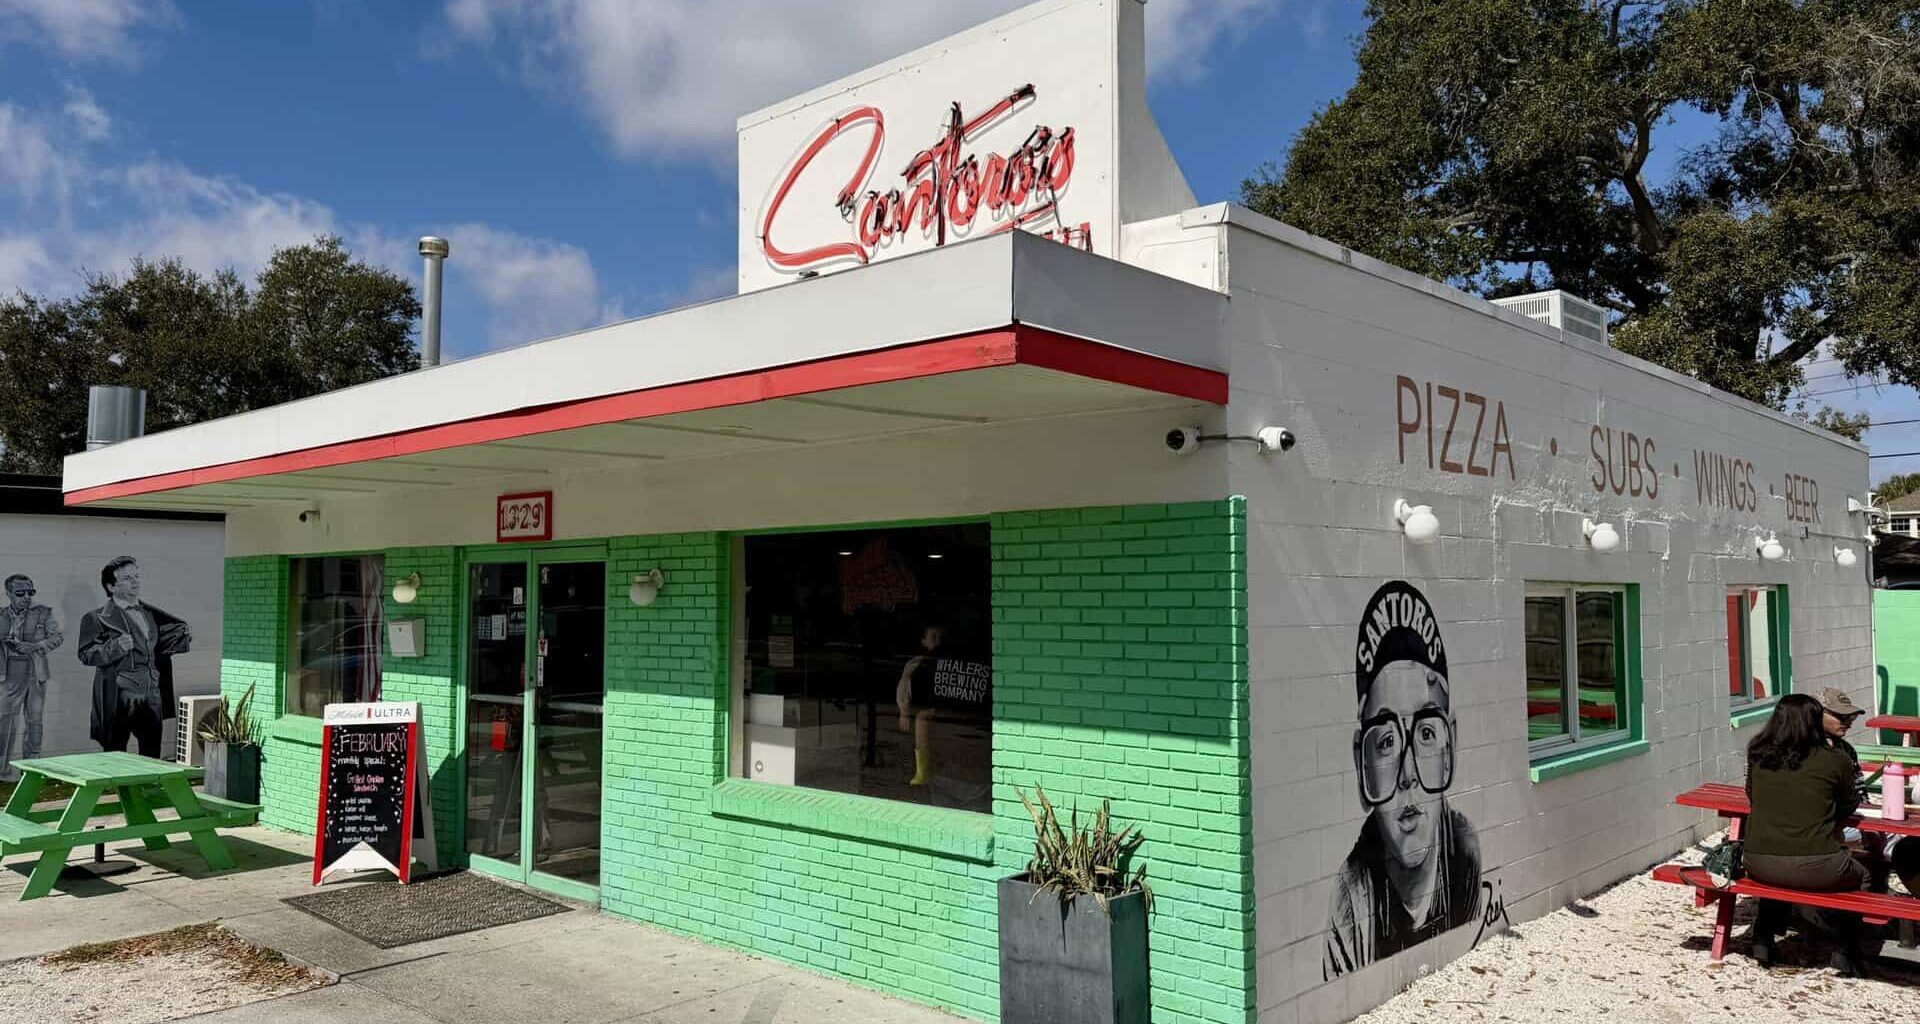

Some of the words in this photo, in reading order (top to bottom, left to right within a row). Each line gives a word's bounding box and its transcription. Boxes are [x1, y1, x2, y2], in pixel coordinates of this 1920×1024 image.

[1396, 374, 1516, 482] PIZZA
[1590, 423, 1658, 500] SUBS
[1693, 448, 1757, 513] WINGS
[1785, 472, 1822, 525] BEER
[500, 501, 544, 531] 1329
[1358, 592, 1442, 673] SANTOROS
[936, 659, 991, 678] WHALERS
[934, 672, 988, 691] BREWING
[934, 684, 986, 704] COMPANY
[374, 707, 411, 718] ULTRA
[339, 732, 406, 753] FEBRUARY
